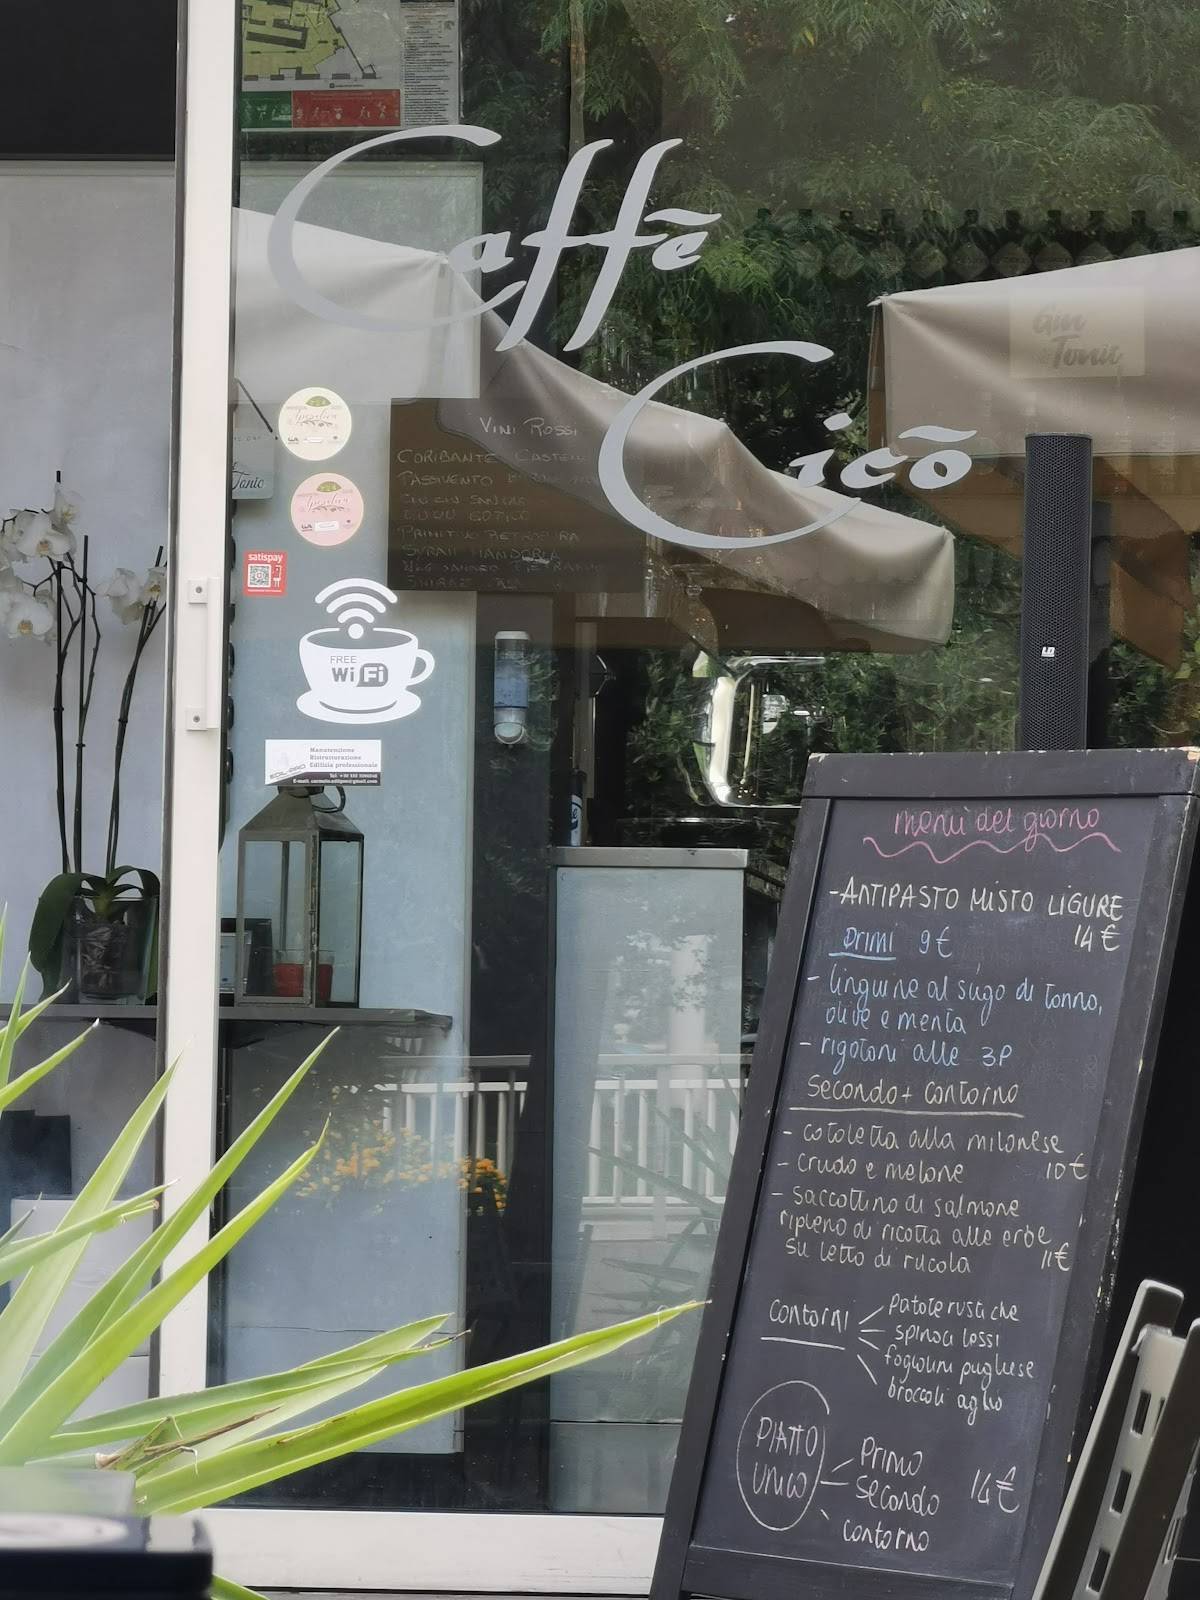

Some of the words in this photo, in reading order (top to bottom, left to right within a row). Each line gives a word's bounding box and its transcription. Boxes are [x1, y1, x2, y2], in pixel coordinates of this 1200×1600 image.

[267, 124, 722, 351] Caffè
[247, 552, 283, 563] satispay
[330, 655, 357, 664] FREE
[976, 806, 1015, 833] del
[1023, 807, 1100, 852] giorno
[829, 963, 919, 1012] linguine
[927, 975, 949, 1001] al
[958, 976, 1005, 1026] sugo
[1016, 977, 1033, 1002] di
[826, 1003, 871, 1030] olive
[880, 1011, 891, 1024] e
[898, 1008, 967, 1034] menta
[912, 1040, 960, 1067] alle
[908, 1126, 954, 1151] alla
[865, 1162, 877, 1178] e
[885, 1162, 965, 1184] melone
[793, 1185, 898, 1214] saccottino
[905, 1192, 923, 1214] di
[934, 1193, 1020, 1219] salmone
[780, 1209, 848, 1239] ripieno
[853, 1219, 872, 1240] di
[882, 1222, 942, 1245] ricotta
[952, 1224, 993, 1247] alle
[1002, 1224, 1053, 1248] erbe
[785, 1238, 810, 1259] su
[820, 1242, 865, 1267] letto
[874, 1250, 892, 1268] di
[903, 1251, 972, 1274] rucola
[962, 1328, 1000, 1348] lessi
[959, 1353, 1035, 1391] pugliese
[887, 1375, 945, 1407] broccoli
[957, 1390, 1003, 1426] aglio
[755, 1416, 818, 1457] PIATTO
[861, 1436, 923, 1476] Primo
